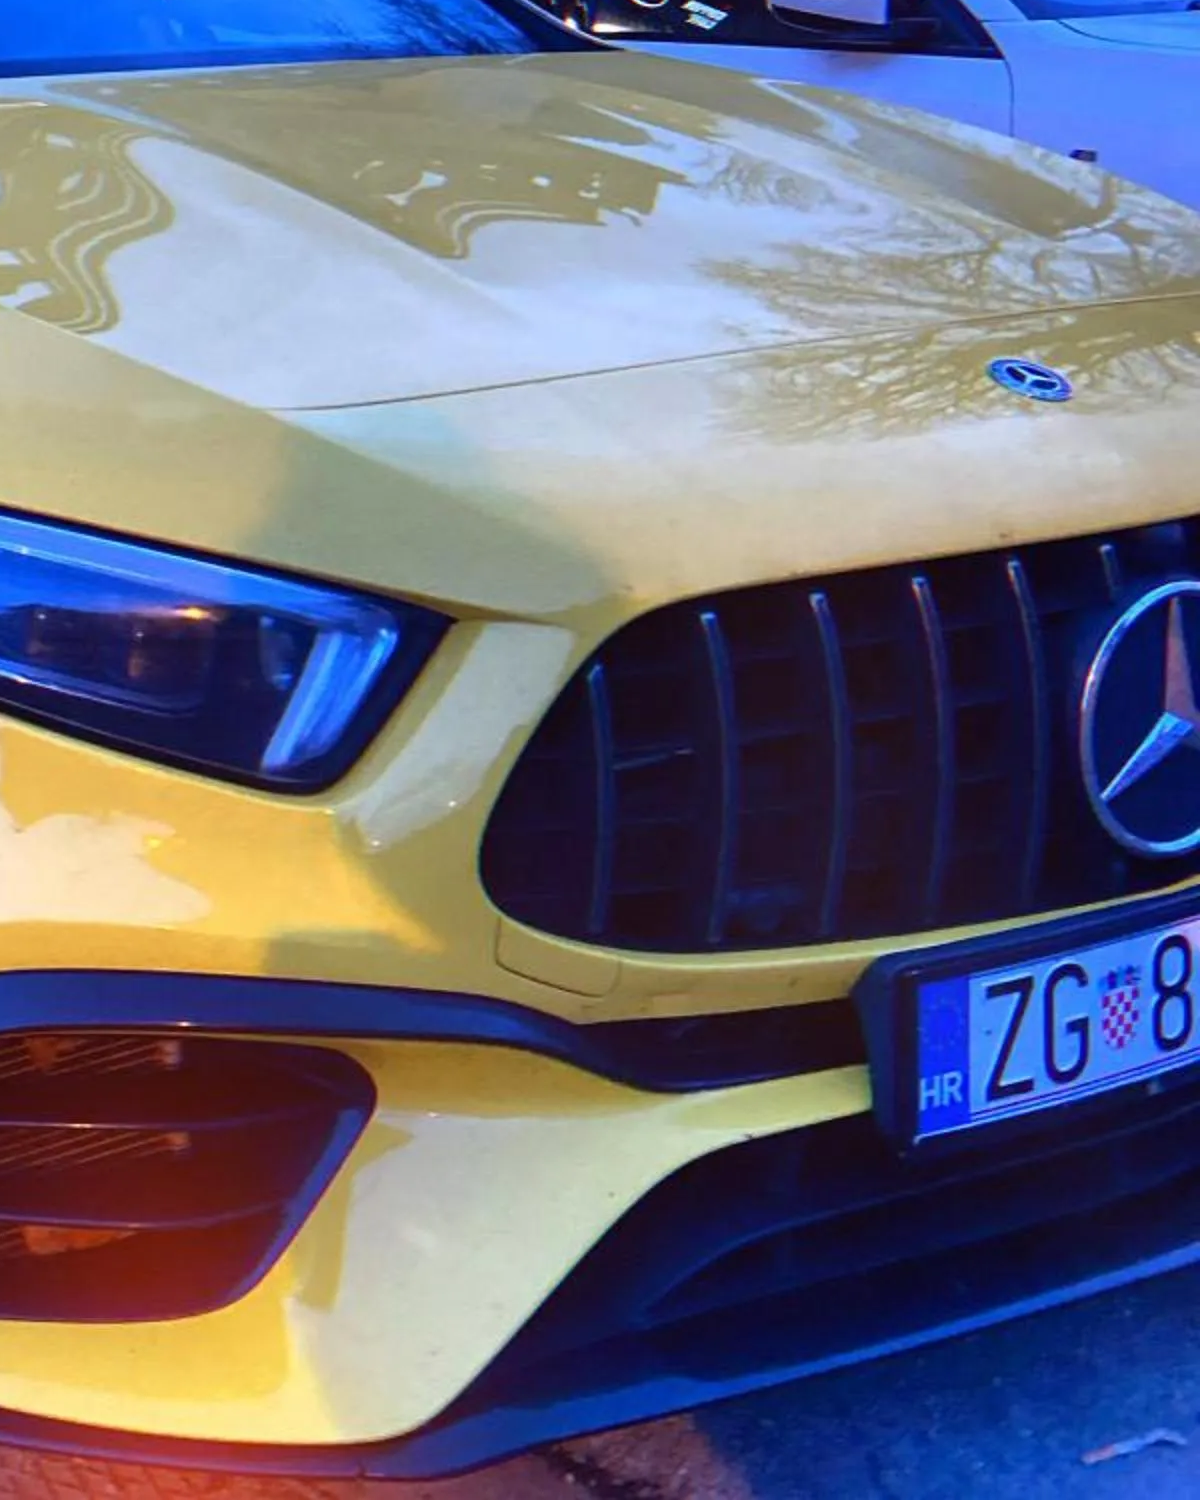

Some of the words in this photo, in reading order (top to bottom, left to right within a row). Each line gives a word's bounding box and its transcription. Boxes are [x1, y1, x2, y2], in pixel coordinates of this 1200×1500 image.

[986, 963, 1089, 1101] ZG
[1153, 934, 1193, 1051] 8
[919, 1071, 963, 1111] HR
